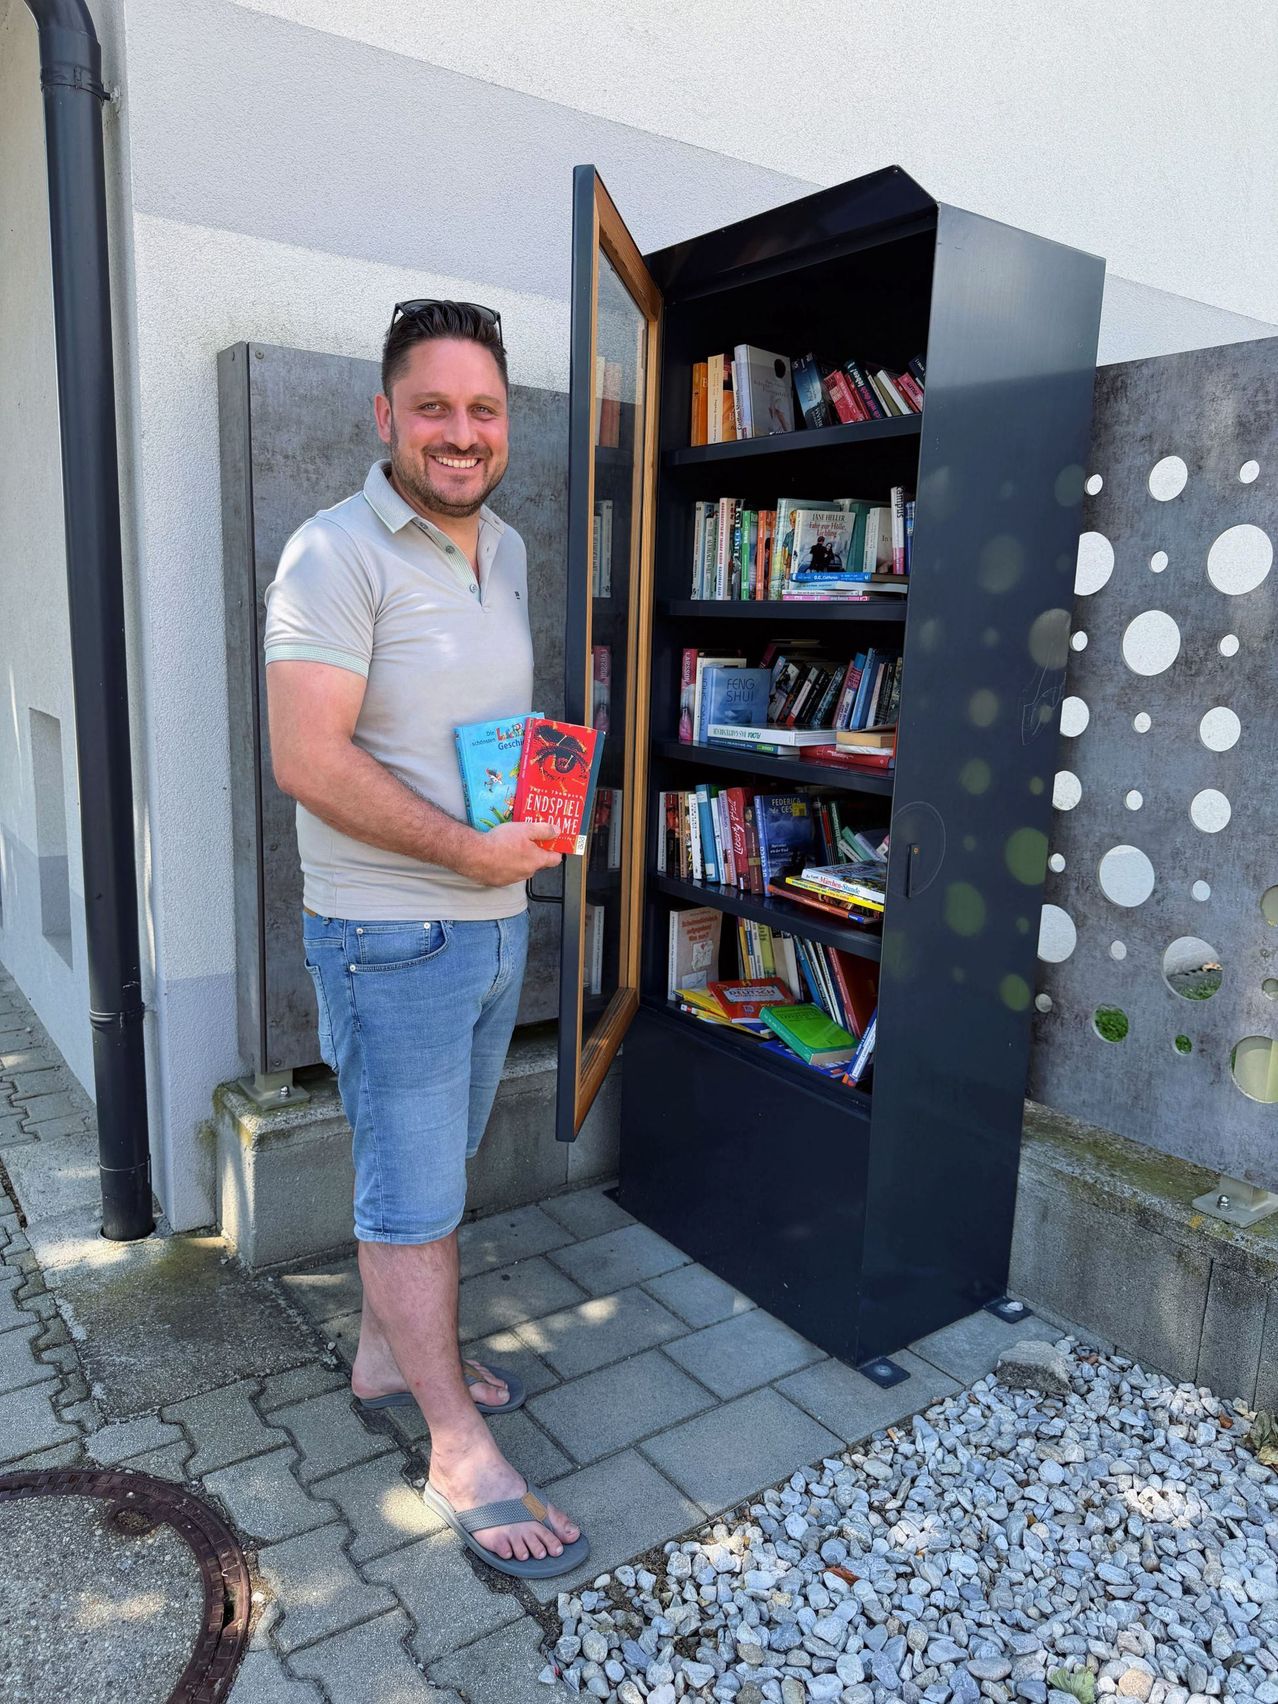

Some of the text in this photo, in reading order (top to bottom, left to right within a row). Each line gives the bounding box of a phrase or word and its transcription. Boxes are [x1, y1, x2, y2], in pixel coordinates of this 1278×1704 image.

[812, 513, 846, 522] JANE HELLER
[727, 678, 755, 690] FENG
[726, 690, 754, 703] SHUI
[526, 793, 580, 818] ENDSPIEL
